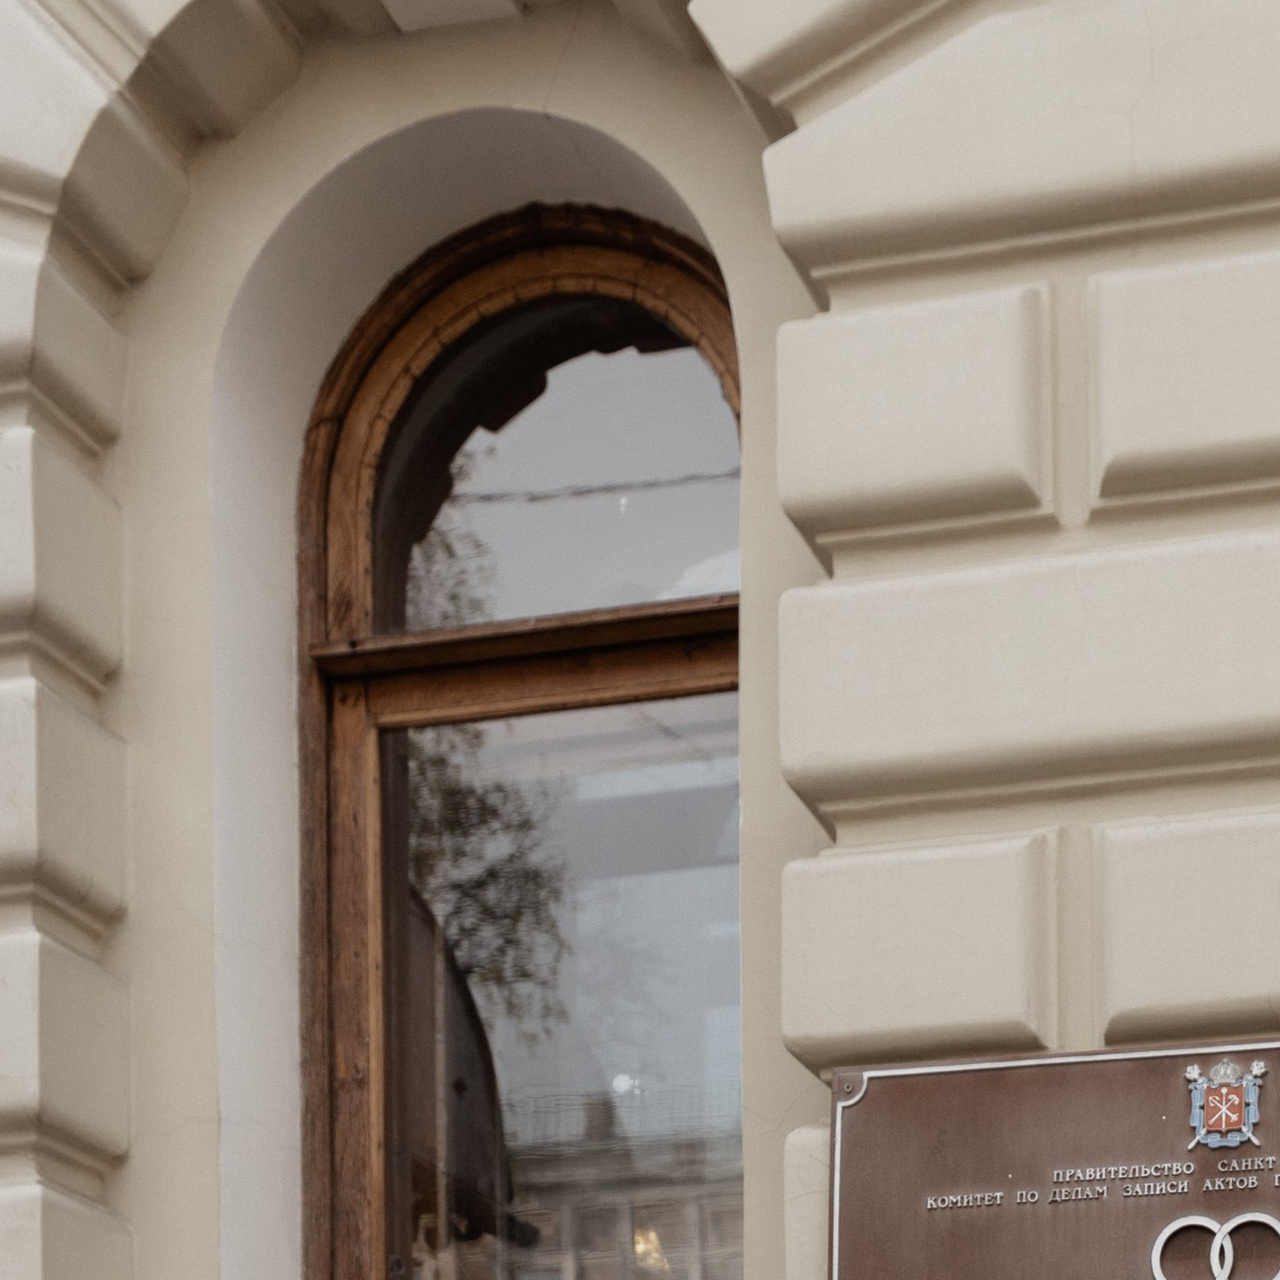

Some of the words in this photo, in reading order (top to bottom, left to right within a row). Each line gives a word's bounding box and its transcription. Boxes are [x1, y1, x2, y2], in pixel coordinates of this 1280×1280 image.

[1053, 1162, 1194, 1183] ПРАВИТЕЛЬСТВО
[926, 1191, 1003, 1209] КОМИТЕТ
[1016, 1190, 1039, 1204] ПО
[1049, 1185, 1108, 1204] ДЕЛАМ
[1122, 1180, 1189, 1197] ЗАПИСИ
[1202, 1175, 1258, 1191] АКТОВ
